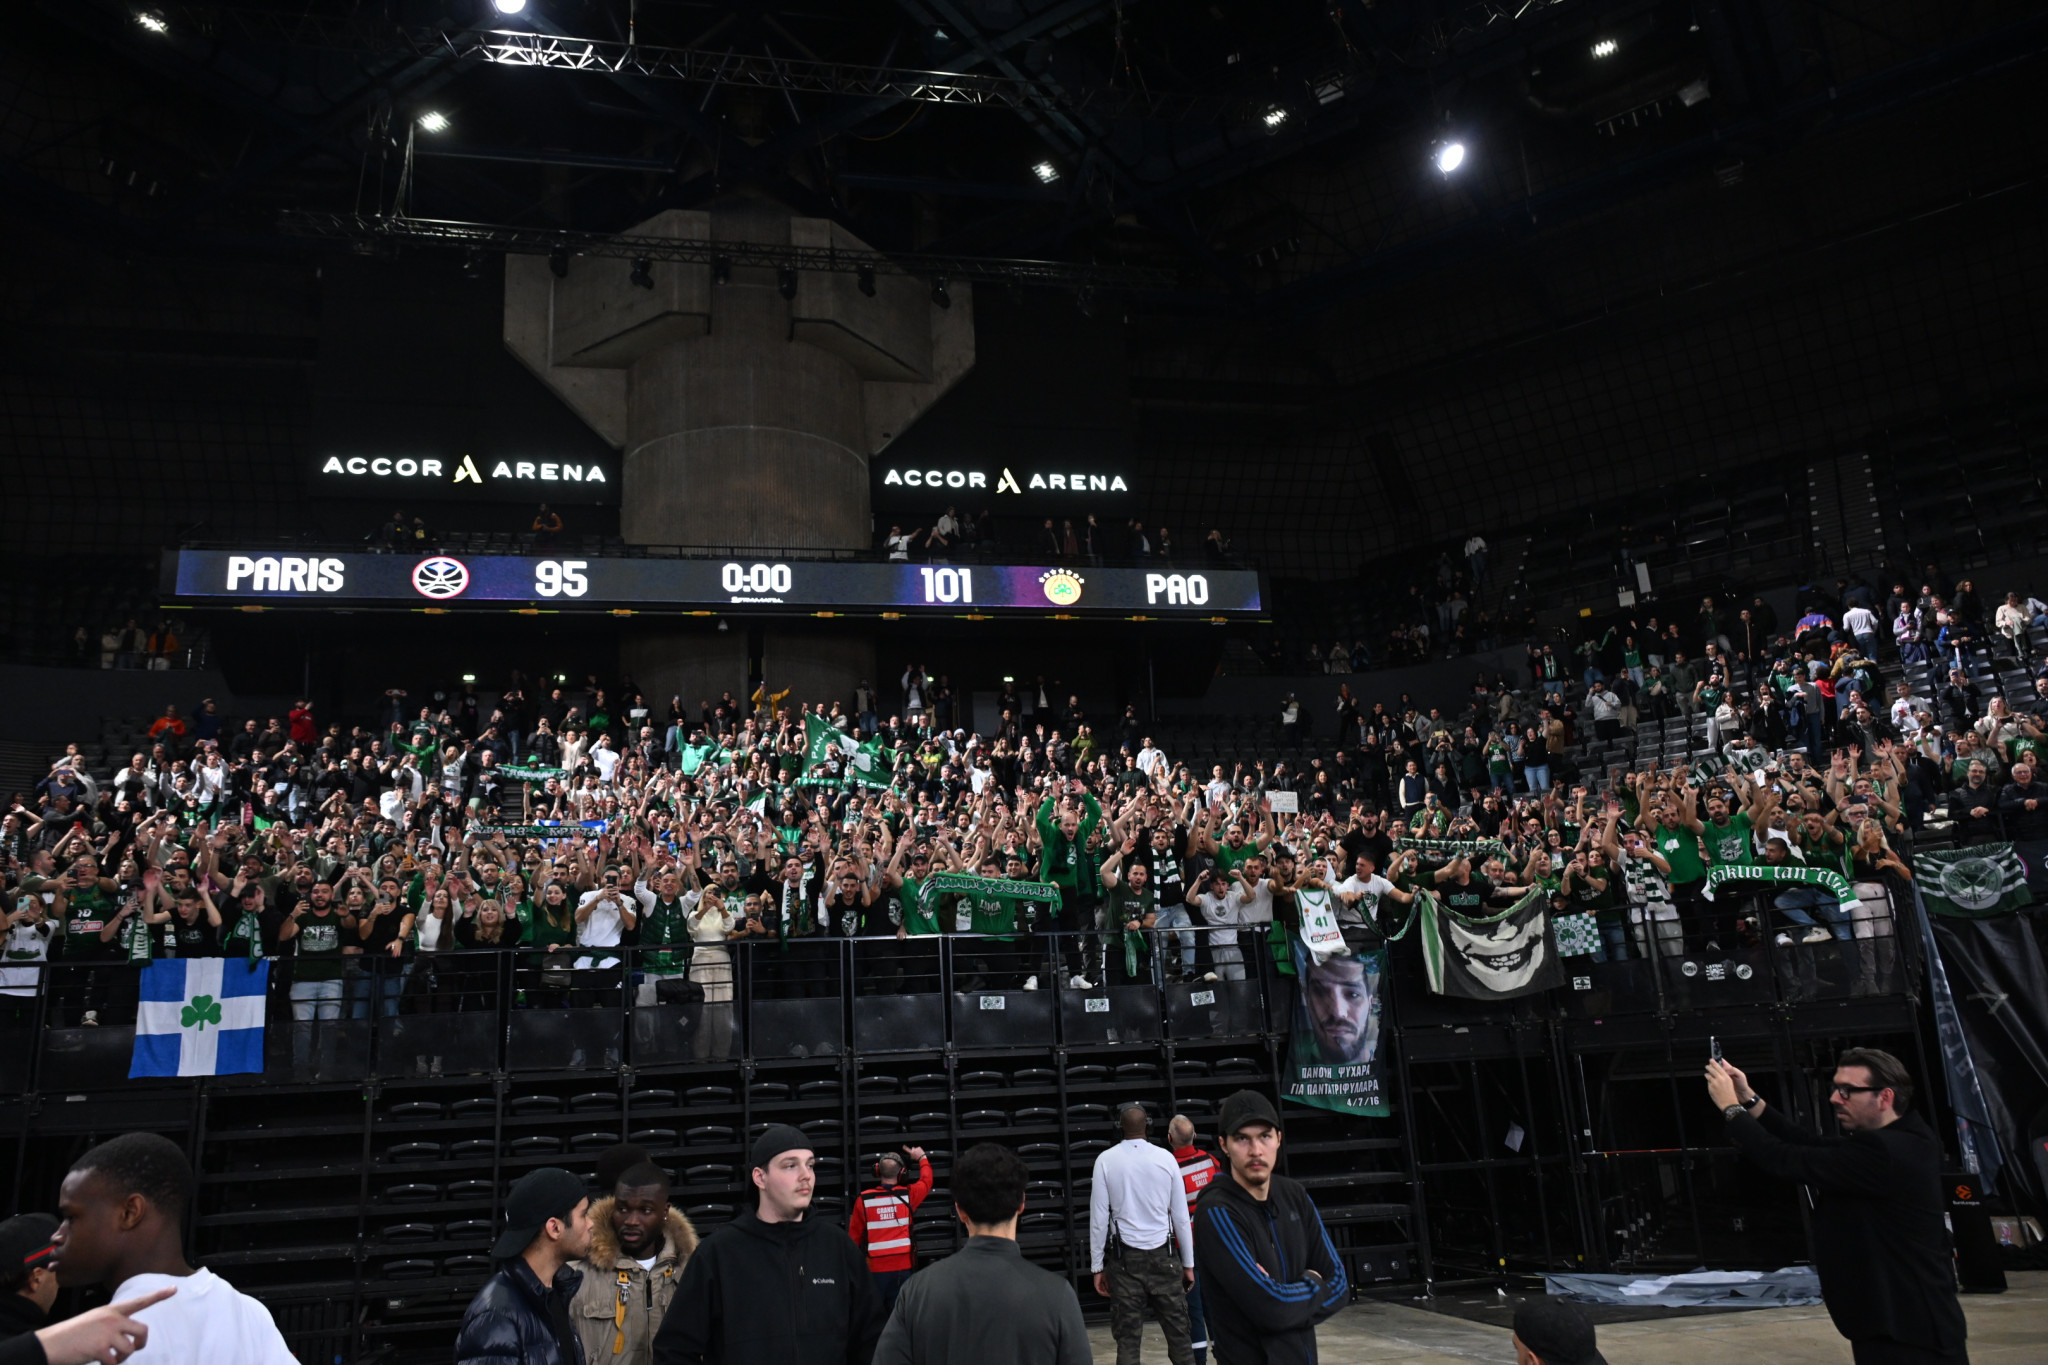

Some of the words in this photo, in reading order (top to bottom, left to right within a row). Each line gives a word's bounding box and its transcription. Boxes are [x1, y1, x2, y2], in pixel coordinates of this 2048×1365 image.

[323, 457, 442, 476] ACCOR
[492, 461, 606, 482] ARENA
[885, 469, 986, 488] ACCOR
[1029, 474, 1127, 491] ARENA
[227, 557, 344, 591] PARIS
[536, 561, 587, 596] 95
[723, 564, 791, 592] 0:00
[921, 568, 971, 602] 101
[1147, 574, 1208, 604] PAO
[727, 904, 738, 912] 44
[1315, 916, 1328, 928] 41
[1346, 1096, 1379, 1107] 4/7/16
[877, 1206, 897, 1214] GRANDE
